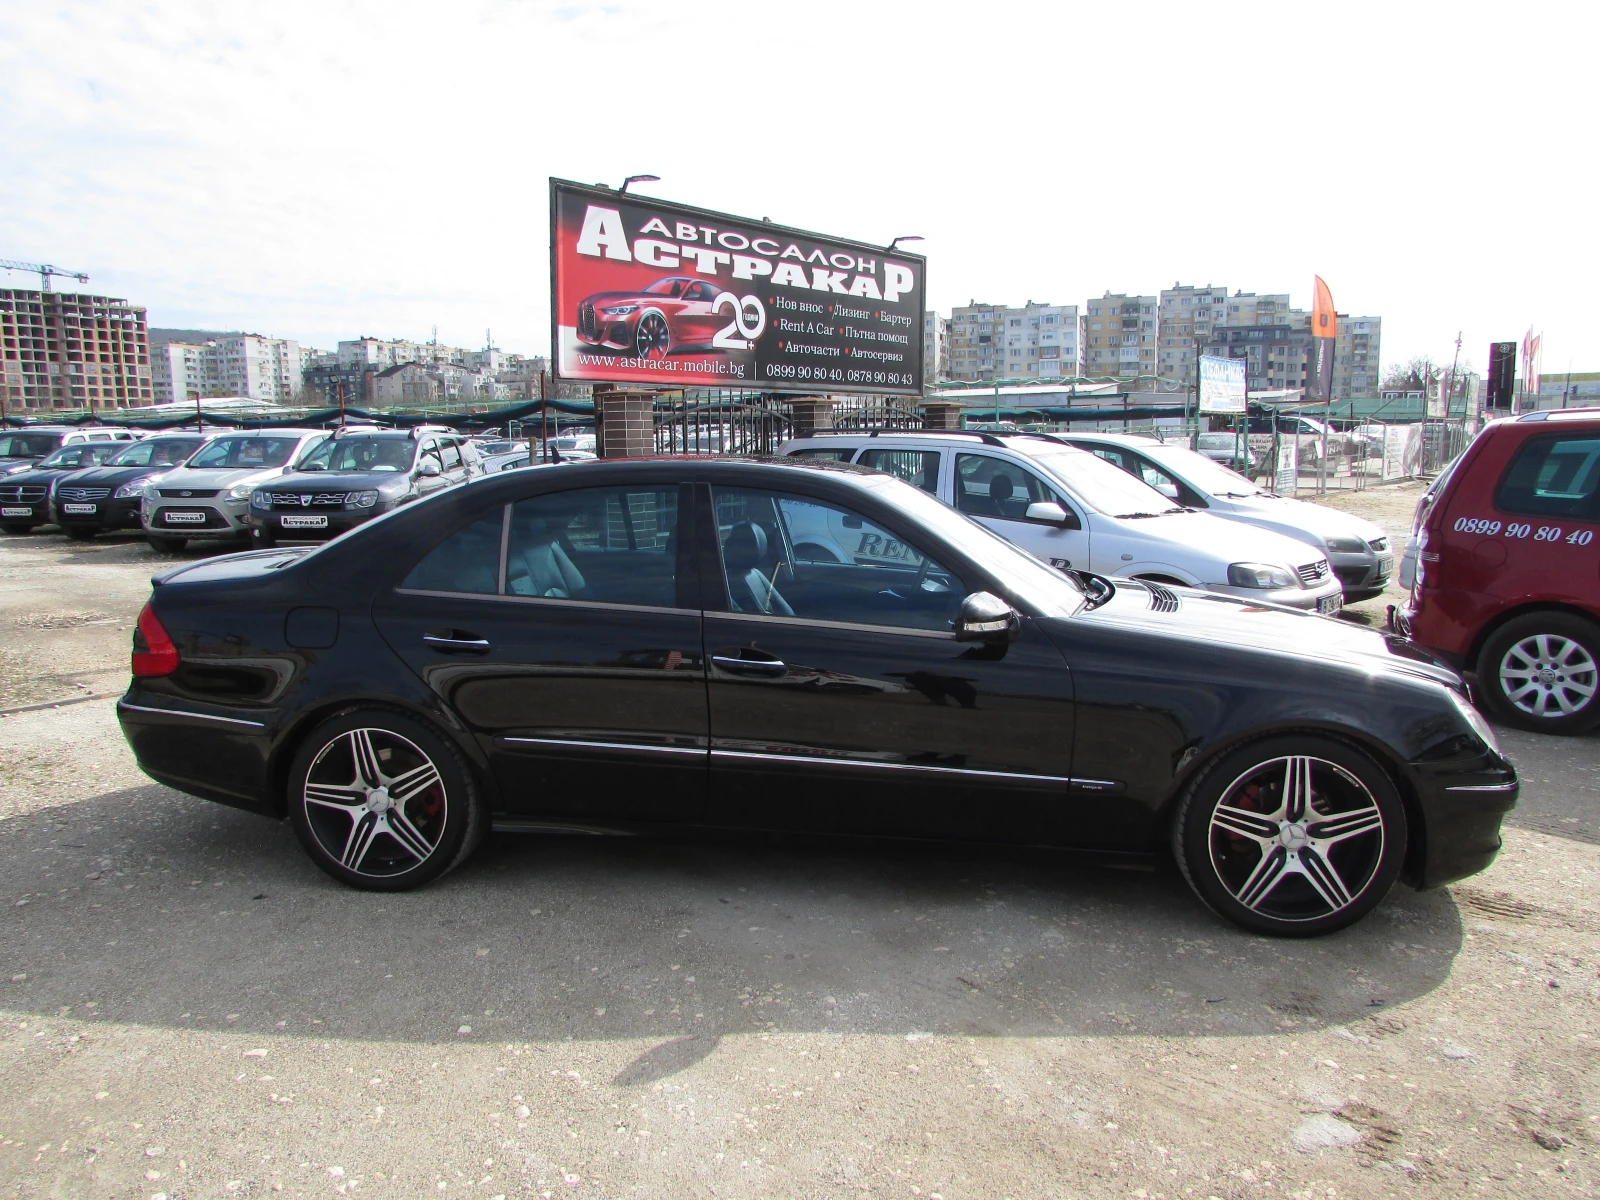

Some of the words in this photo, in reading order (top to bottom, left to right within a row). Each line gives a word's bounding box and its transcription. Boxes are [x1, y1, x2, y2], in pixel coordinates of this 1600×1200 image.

[576, 204, 914, 303] АСТРАКАР
[640, 217, 876, 275] АВТОСАЛОН
[776, 296, 797, 310] Нов
[799, 302, 824, 314] внос
[834, 304, 870, 320] Лизинг
[880, 310, 912, 327] Бартер
[780, 318, 805, 333] Rent
[806, 322, 814, 334] A
[816, 323, 834, 336] Car
[845, 326, 876, 340] Пътна
[878, 332, 908, 345] помощ
[785, 341, 840, 356] Авточасти
[851, 347, 903, 363] Автосервиз
[577, 354, 745, 379] www.astracar.mobile.bg
[766, 364, 795, 377] 0899
[798, 366, 811, 379] 90
[814, 367, 827, 380] 80
[829, 369, 845, 382] 40,
[847, 369, 872, 383] 0878
[874, 371, 886, 384] 90
[888, 373, 899, 385] 80
[901, 374, 913, 385] 43
[283, 516, 326, 526] АСТРАКАР
[1454, 517, 1501, 535] 0899
[1505, 522, 1531, 539] 90
[1533, 526, 1561, 542] 80
[1565, 529, 1593, 546] 40
